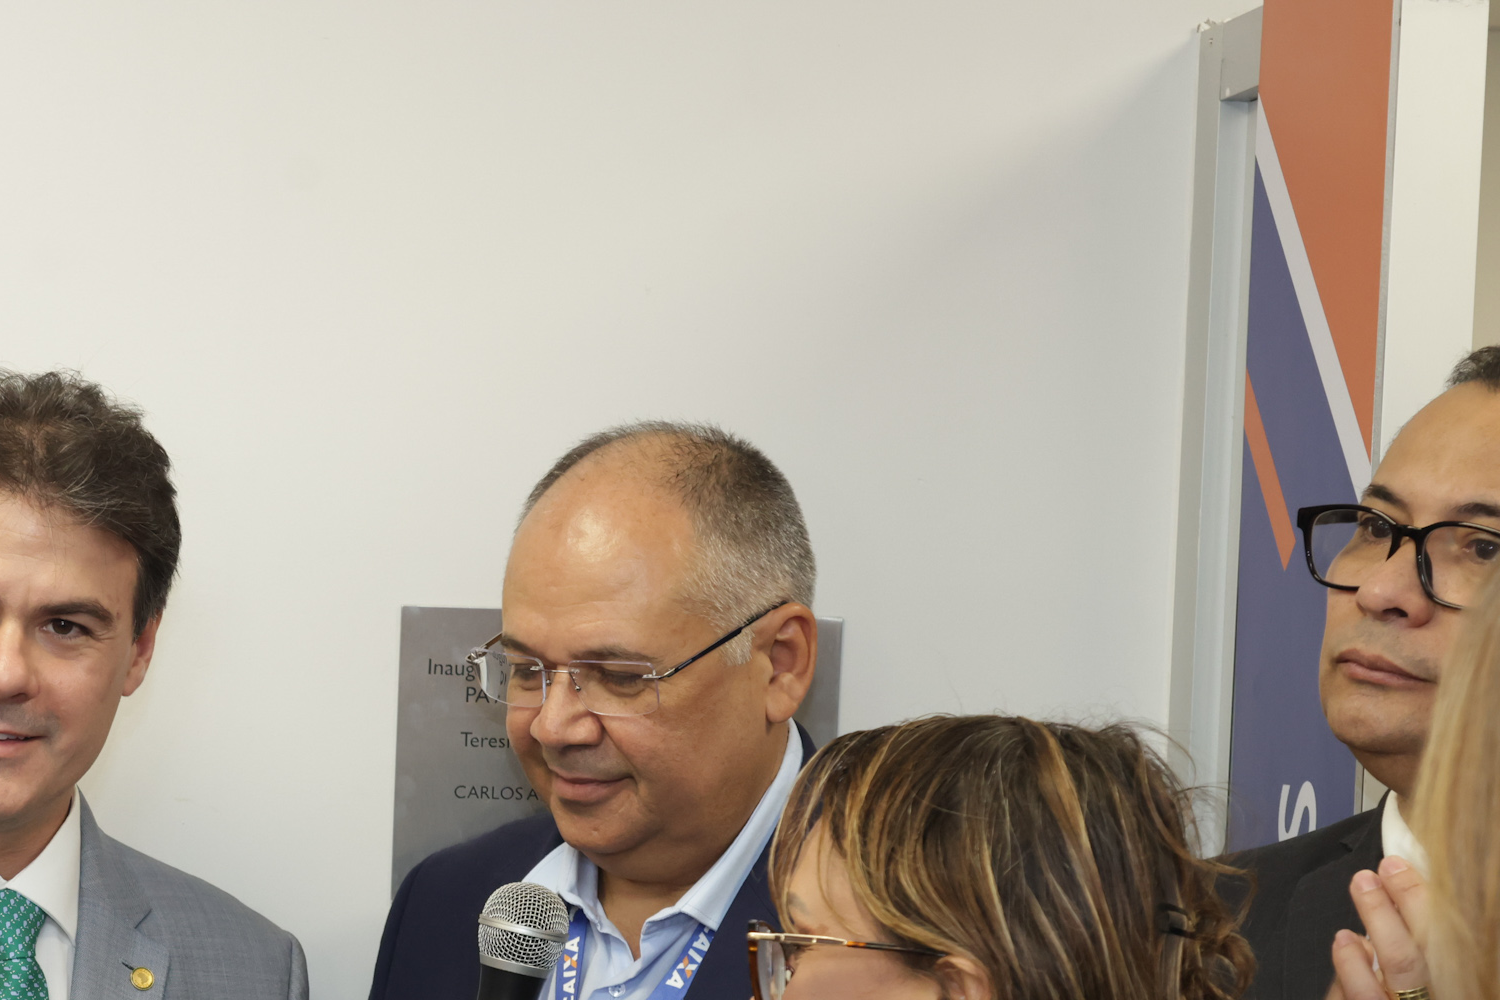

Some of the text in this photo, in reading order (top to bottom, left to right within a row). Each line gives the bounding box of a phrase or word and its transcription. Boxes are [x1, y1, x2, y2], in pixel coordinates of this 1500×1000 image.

[427, 658, 476, 682] Inaug
[454, 785, 524, 800] CARLOS
[665, 926, 711, 989] AIXA
